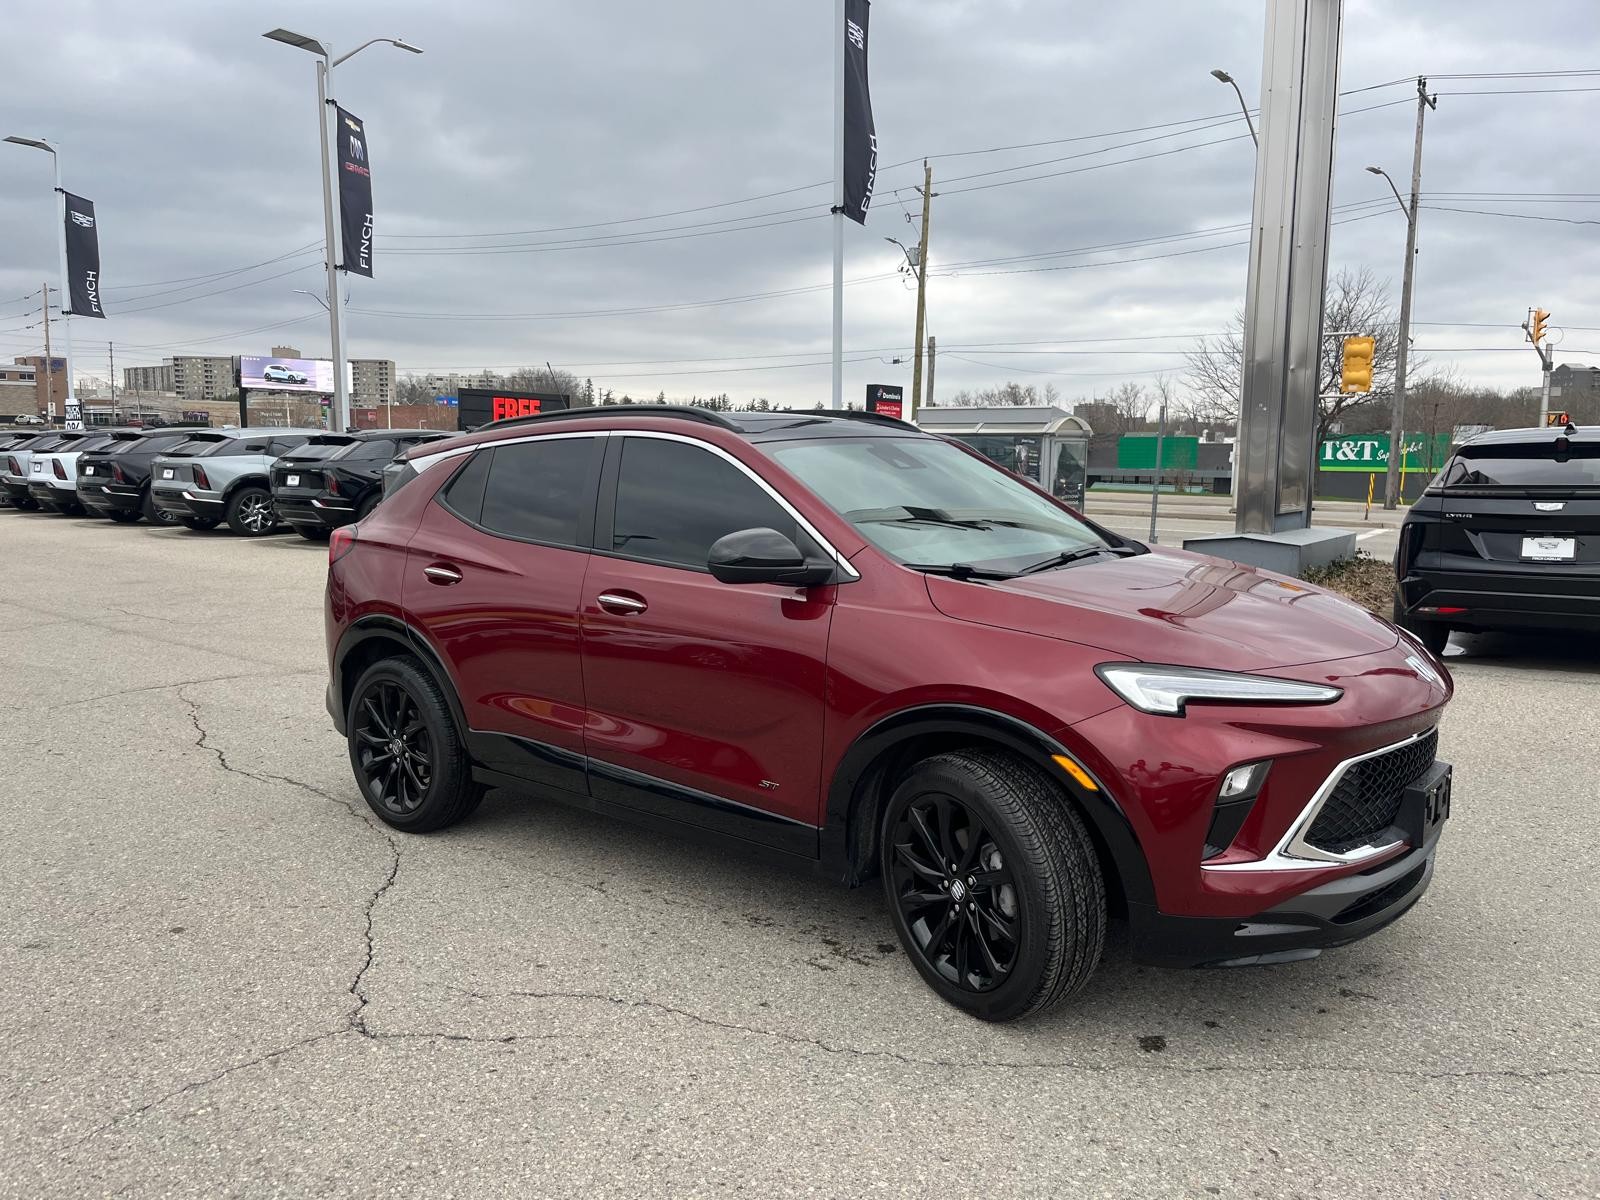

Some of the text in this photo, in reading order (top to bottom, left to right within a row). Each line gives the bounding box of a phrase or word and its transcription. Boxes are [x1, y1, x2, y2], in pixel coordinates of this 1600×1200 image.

[861, 134, 878, 213] FINCH
[360, 213, 374, 269] FINCH
[86, 270, 101, 313] FINCH
[493, 397, 541, 422] FREE
[1322, 440, 1379, 461] T&T
[758, 779, 780, 790] ST
